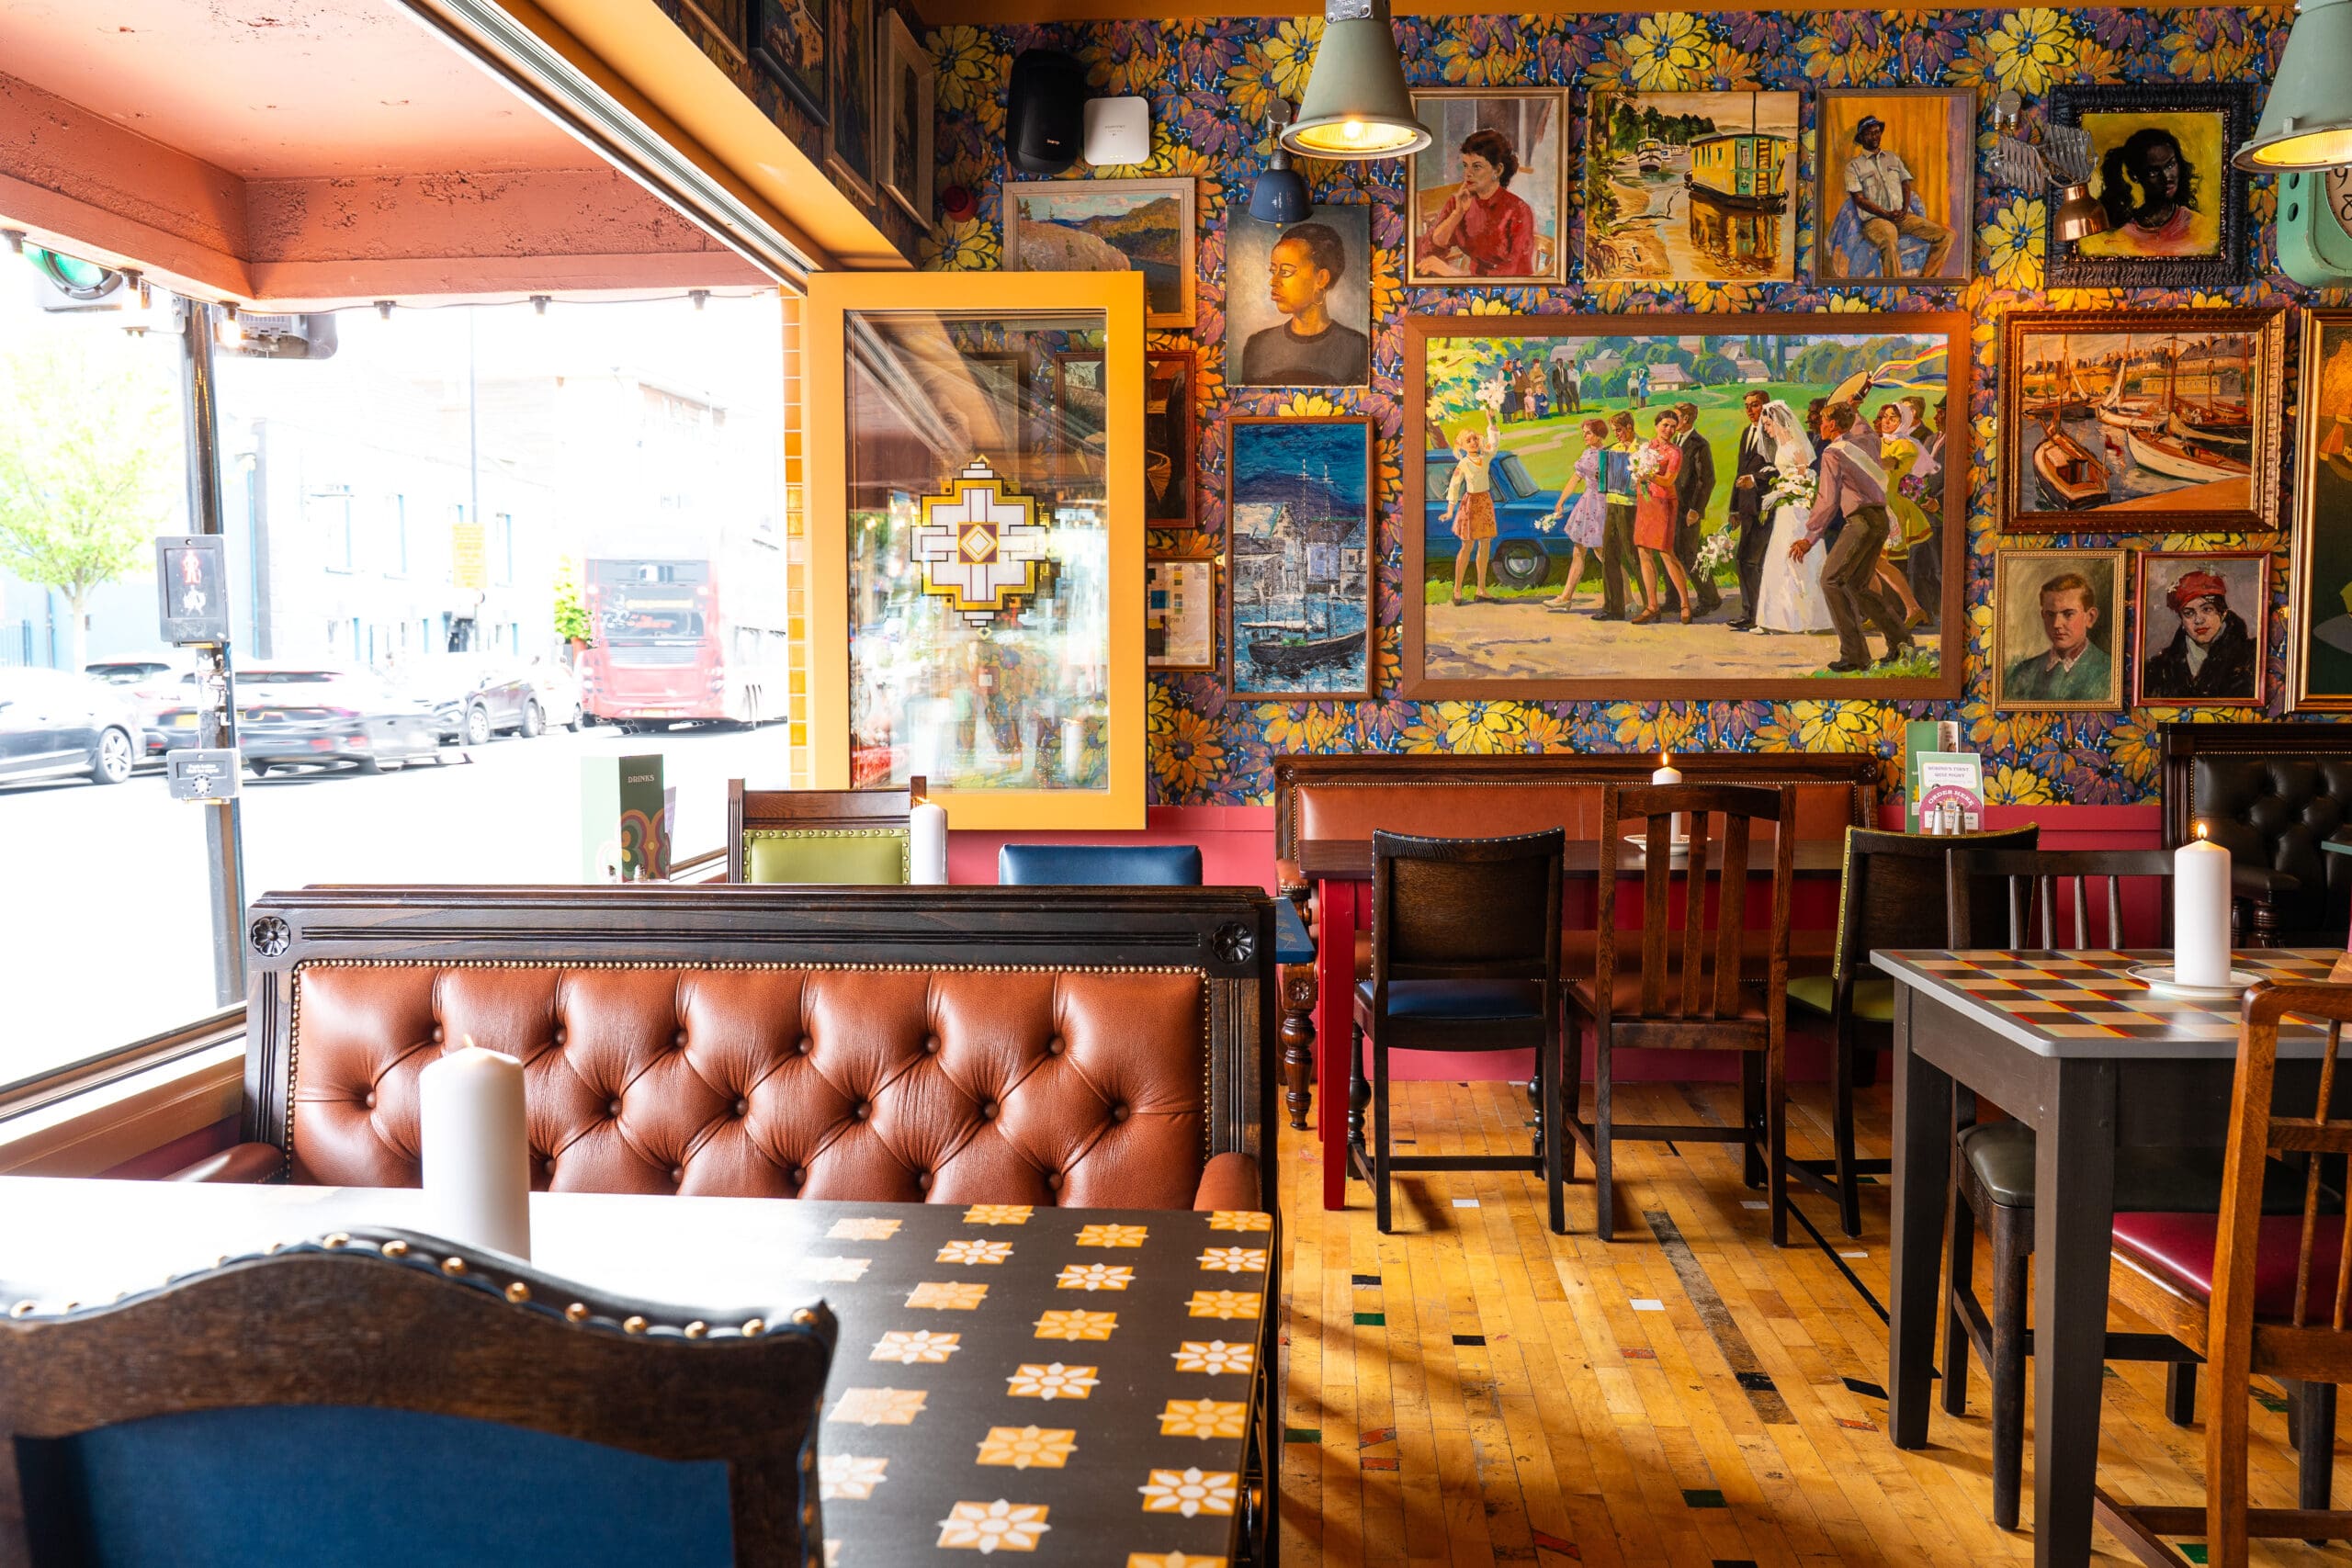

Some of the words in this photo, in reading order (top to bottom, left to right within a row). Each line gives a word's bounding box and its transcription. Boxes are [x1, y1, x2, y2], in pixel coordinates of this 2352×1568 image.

[2334, 168, 2348, 190] 9
[628, 774, 655, 784] DRINKS
[1928, 789, 1953, 805] ORDER
[1954, 789, 1974, 807] HERE
